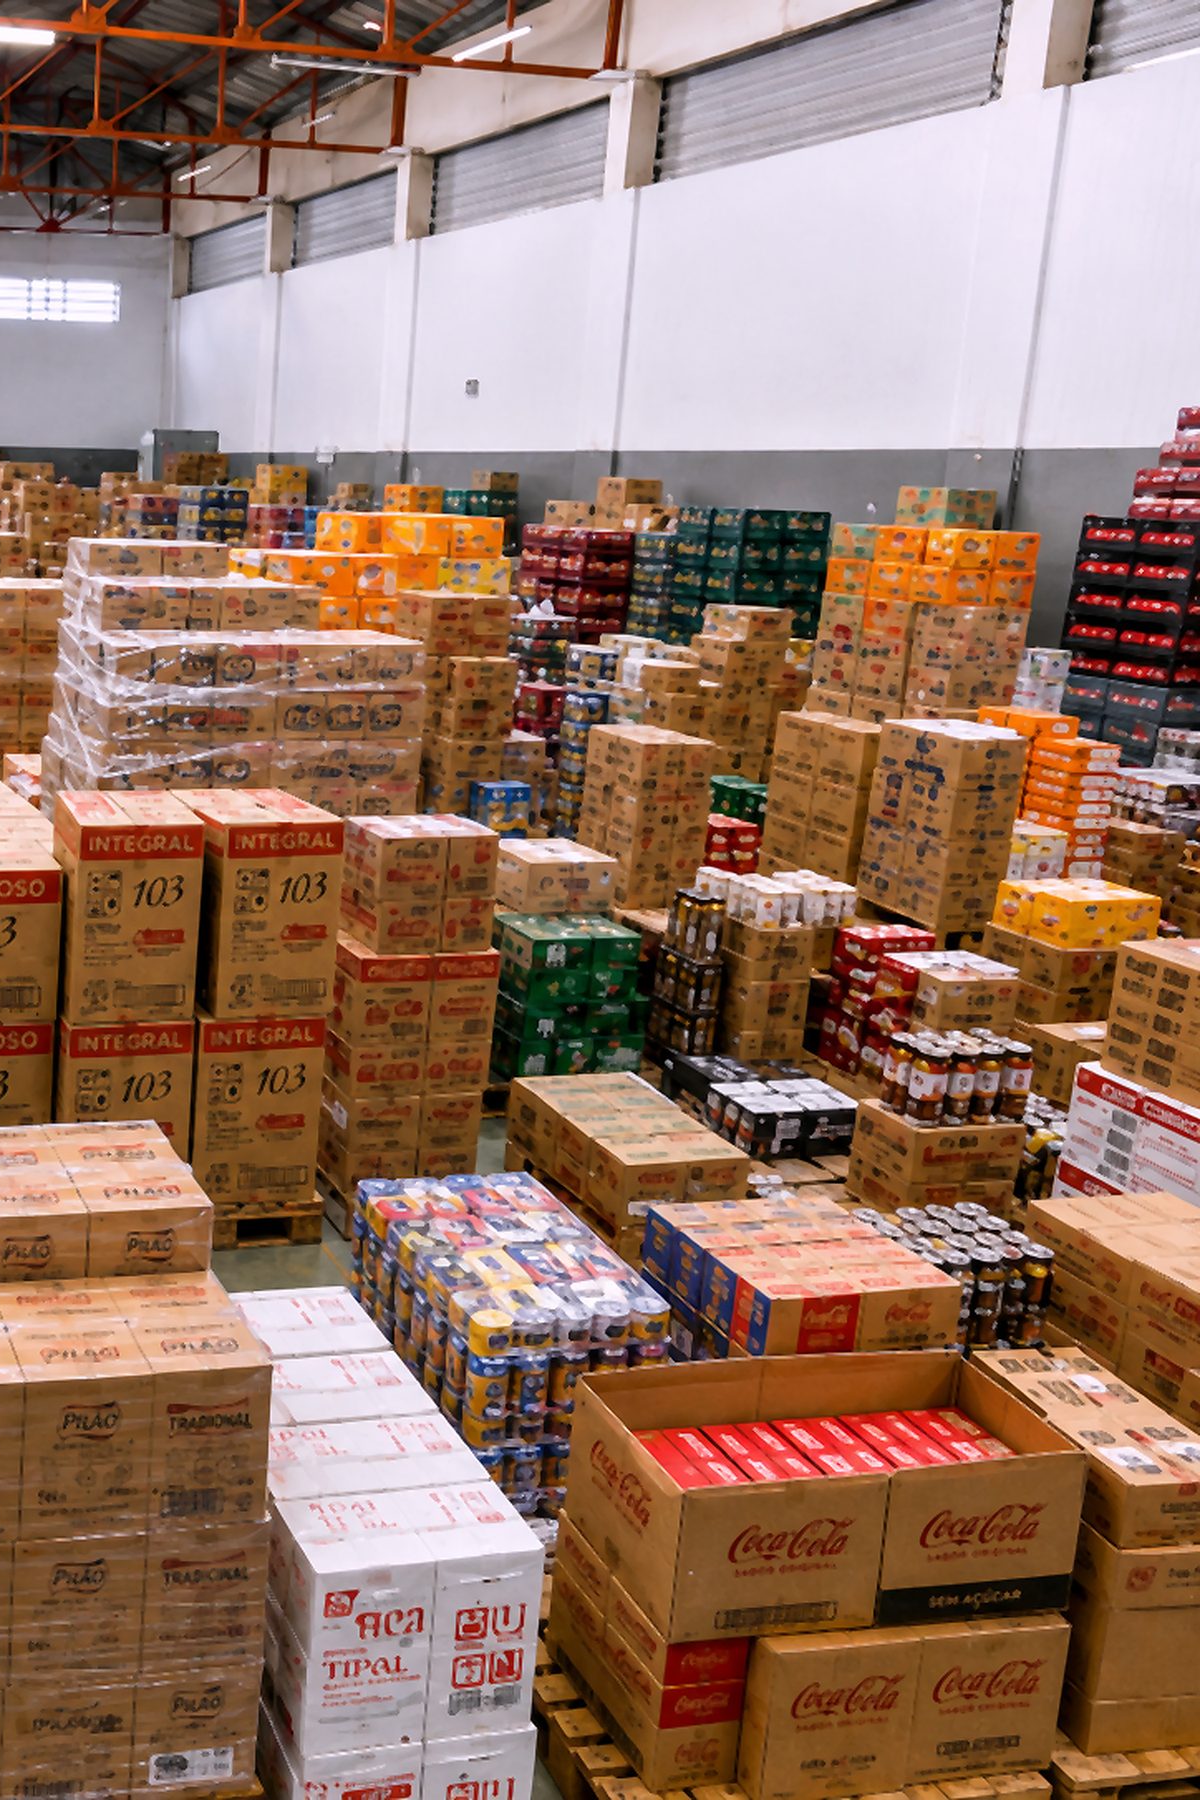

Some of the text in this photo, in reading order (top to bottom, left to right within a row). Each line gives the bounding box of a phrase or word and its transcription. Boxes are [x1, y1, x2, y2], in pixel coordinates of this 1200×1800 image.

[89, 834, 194, 852] INTEGRAL
[235, 831, 335, 849] INTEGRAL
[132, 874, 185, 908] 103
[279, 871, 328, 904] 103
[78, 1032, 184, 1052] INTEGRAL
[211, 1025, 315, 1046] INTEGRAL
[122, 1070, 172, 1103] 103
[257, 1064, 307, 1097] 103
